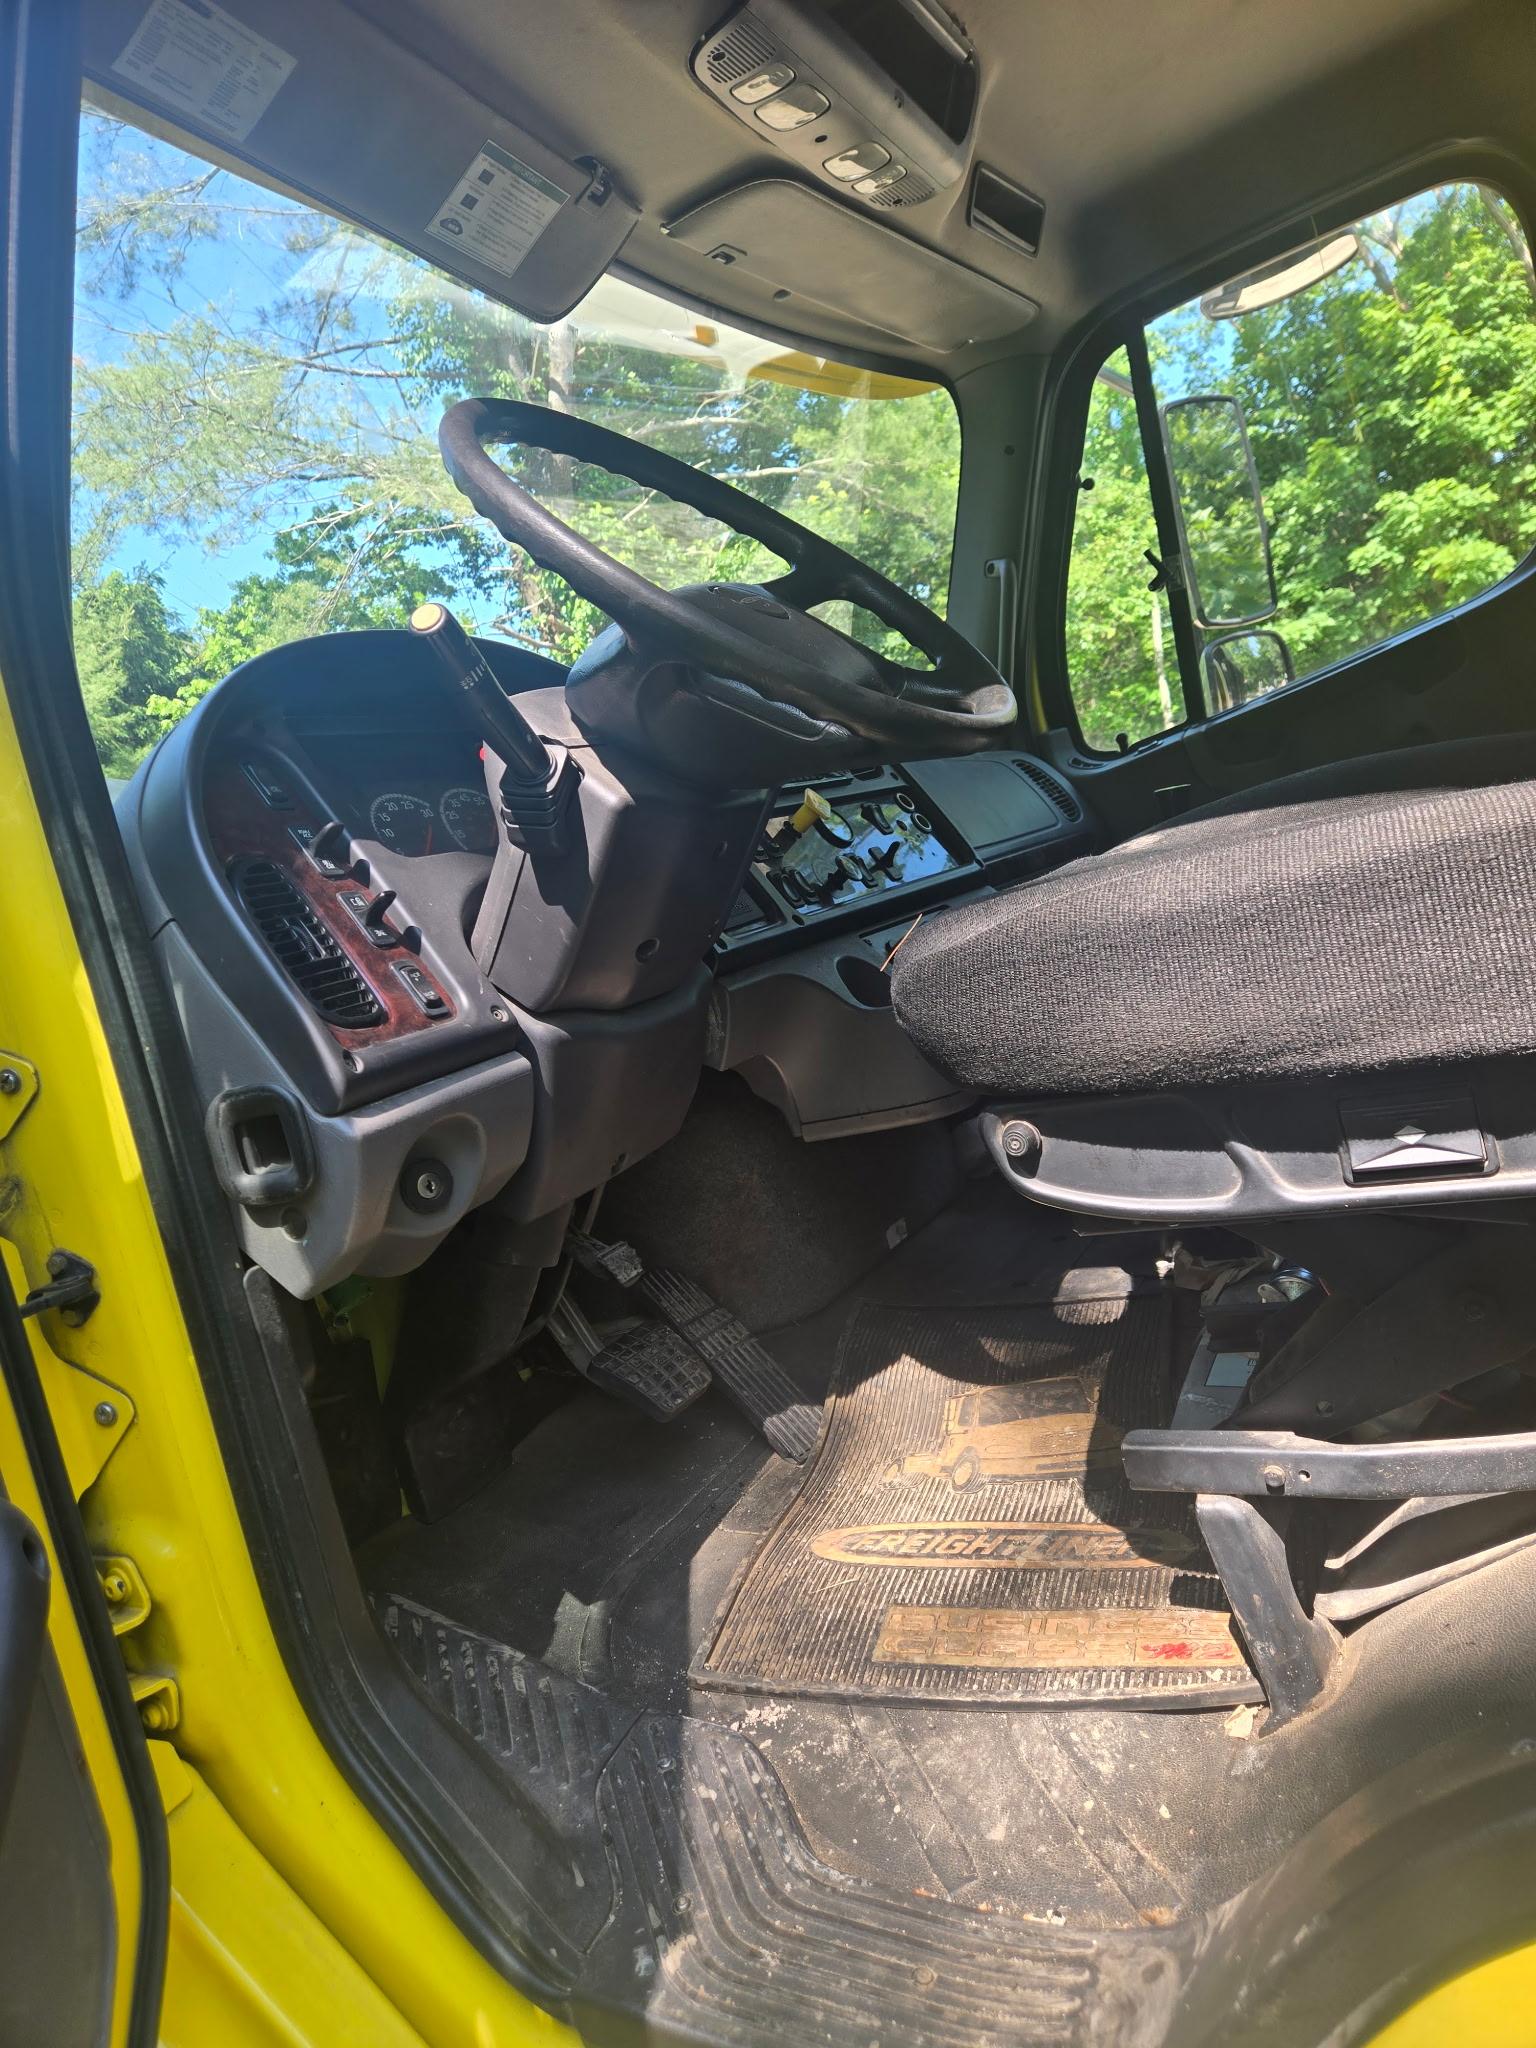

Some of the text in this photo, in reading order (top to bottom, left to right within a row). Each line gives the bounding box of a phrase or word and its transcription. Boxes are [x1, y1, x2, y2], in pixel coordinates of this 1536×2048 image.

[384, 801, 399, 811] 20
[400, 800, 415, 810] 25
[378, 812, 391, 822] 15
[420, 808, 434, 818] 30
[382, 828, 395, 839] 10
[889, 1613, 1229, 1637] BUSINESS
[882, 1635, 1133, 1660] CLASS
